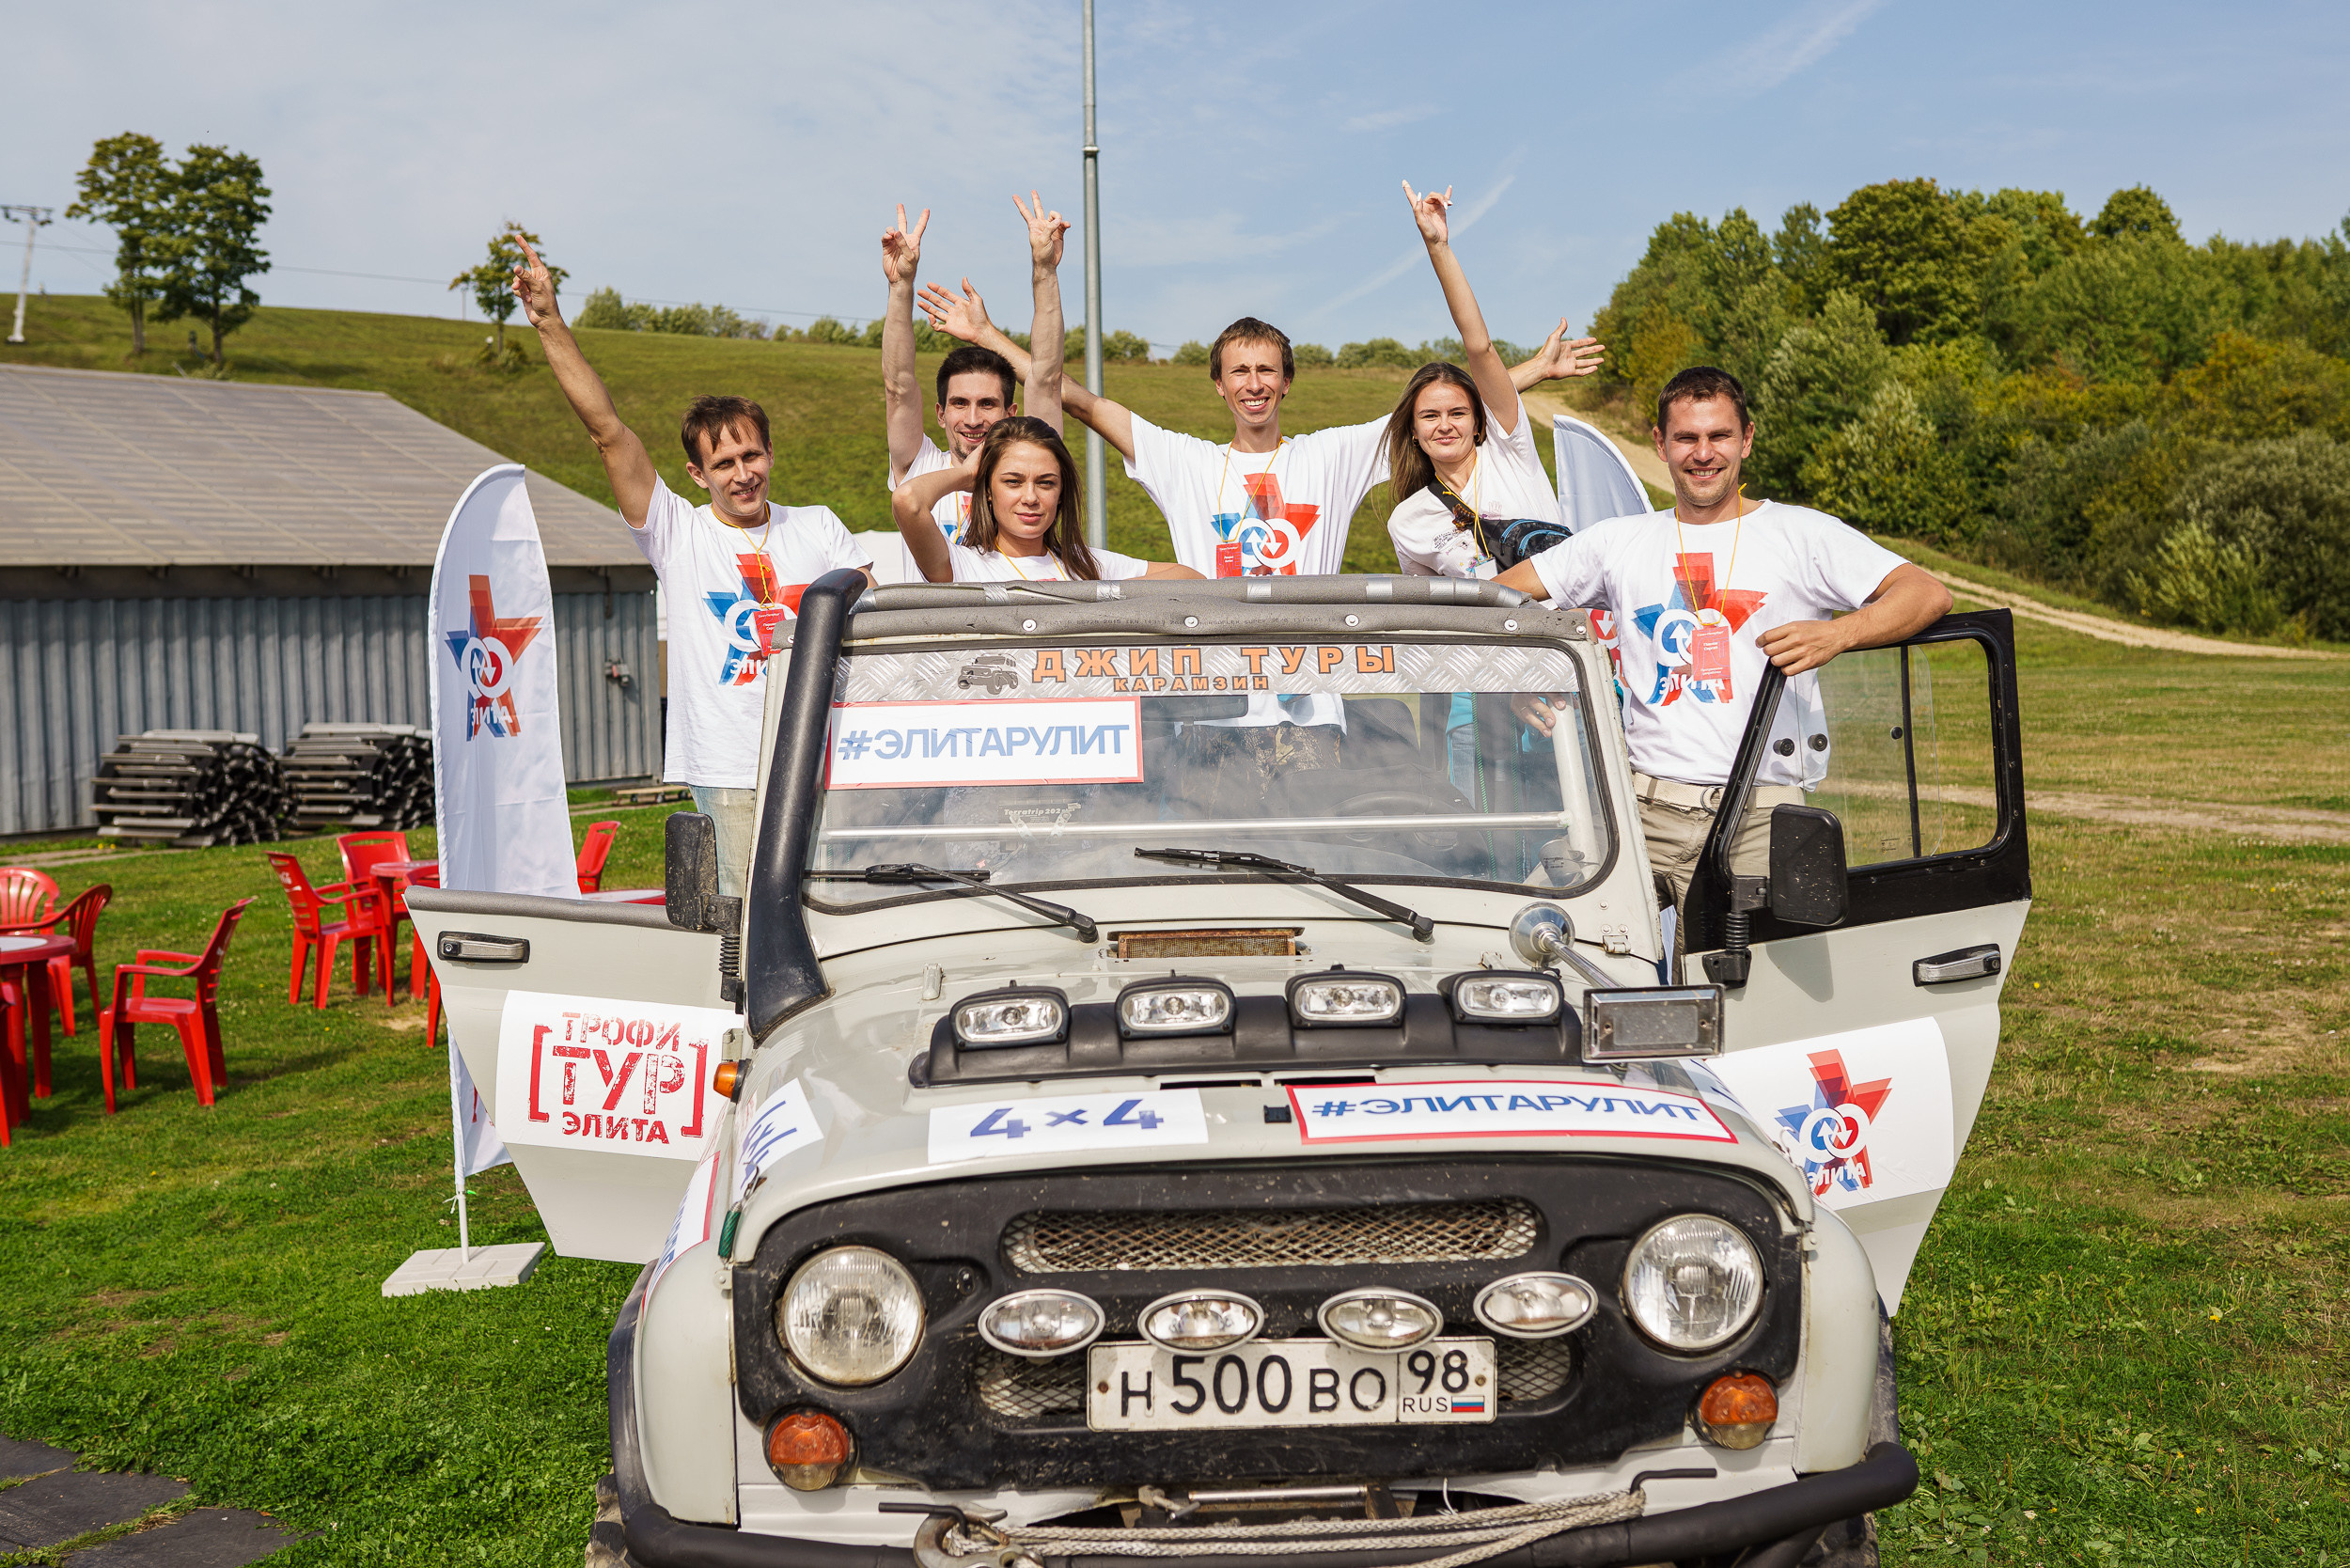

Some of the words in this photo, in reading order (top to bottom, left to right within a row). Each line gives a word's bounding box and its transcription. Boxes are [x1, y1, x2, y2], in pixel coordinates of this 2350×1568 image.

[730, 659, 767, 674] ЭЛИ
[1032, 647, 1203, 683] ДЖИП
[1240, 645, 1396, 675] ТУРЫ
[1113, 675, 1269, 693] КАРАМЗИН
[838, 724, 1130, 760] #ЭЛИТАРУЛИТ
[562, 1011, 682, 1052] ТРОФИ
[553, 1045, 686, 1115] ТУР
[1311, 1093, 1700, 1121] #ЭЛИТАРУЛИТ
[562, 1110, 670, 1145] ЭЛИТА
[1407, 1349, 1469, 1394] 98
[1402, 1397, 1448, 1413] RUS
